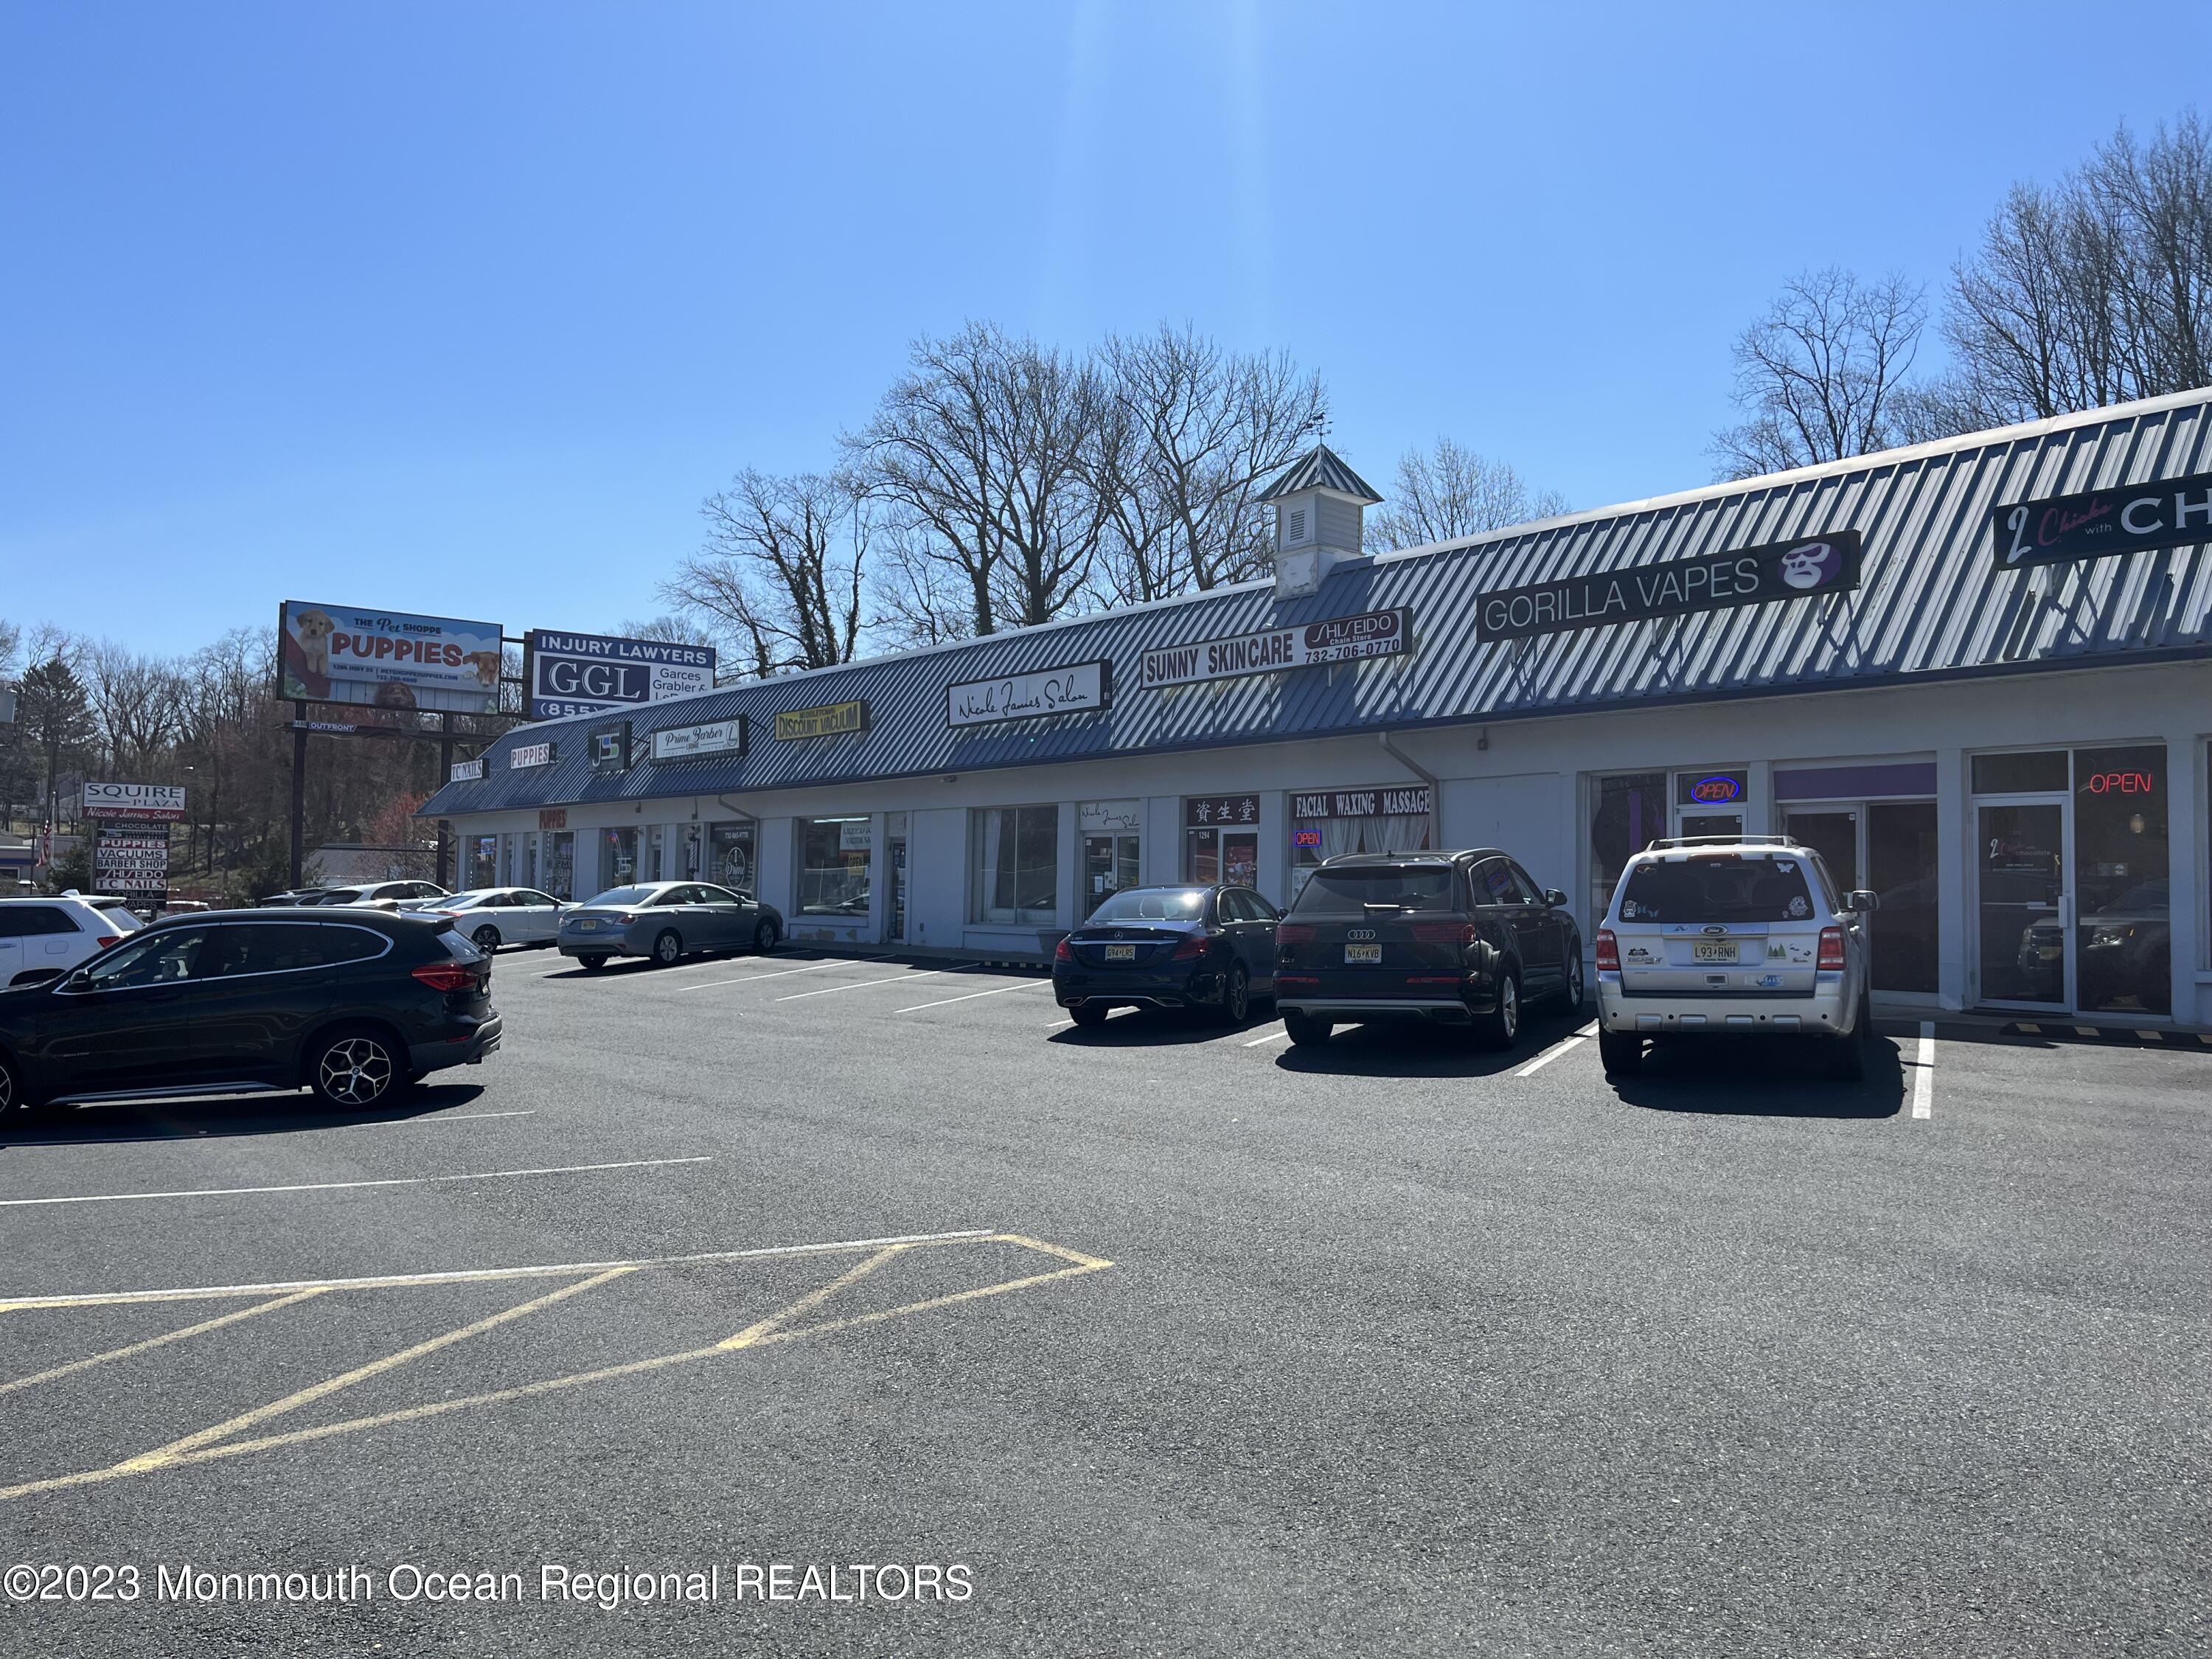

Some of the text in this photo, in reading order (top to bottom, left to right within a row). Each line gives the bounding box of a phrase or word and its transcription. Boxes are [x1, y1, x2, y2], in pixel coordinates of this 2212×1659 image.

[2006, 506, 2032, 564] 2
[2084, 523, 2112, 535] with
[2121, 487, 2212, 535] CH
[1485, 557, 1759, 631] GORILLA VAPES
[354, 618, 442, 635] THE Pet SHOPPE
[1311, 615, 1392, 643] SHISEIDO
[1329, 634, 1372, 646] Chain Store
[332, 632, 463, 667] PUPPIES
[541, 636, 707, 664] INJURY LAWYERS
[1305, 638, 1399, 664] 732-706-0770
[1147, 633, 1293, 683] SUNNY SKINCARE
[549, 662, 641, 699] GGL
[660, 668, 701, 681] Garces
[653, 680, 696, 693] Grabler
[959, 674, 1088, 719] Nicole James Salon
[779, 704, 858, 737] DISCOUNT VACUUM
[799, 707, 836, 719] MIDDLETOWN
[310, 722, 354, 731] OUTFRONT
[665, 727, 723, 747] Prime Barber
[512, 748, 549, 768] PUPPIES
[452, 760, 482, 781] TC NAILS
[1695, 783, 1735, 799] OPEN
[2090, 773, 2152, 793] OPEN
[88, 785, 181, 799] SQUIRE
[133, 799, 180, 807] PLAZA
[1296, 790, 1430, 818] FACIAL WAXING MASSAGE
[87, 807, 180, 820] Nicole James Salon
[539, 808, 567, 830] PUPPIES
[1196, 799, 1256, 824] 資生堂
[114, 822, 167, 830] CHOCOLATE
[101, 839, 166, 848] PUPPIES
[1198, 831, 1210, 841] 1294
[1296, 832, 1320, 845] OPEN
[100, 849, 163, 859] VACUUMS
[97, 859, 167, 869] BARBER SHOP
[101, 869, 164, 879] SHISEIDO
[125, 879, 166, 889] NAILS
[109, 890, 154, 899] GORILLA
[123, 900, 157, 910] VAPES
